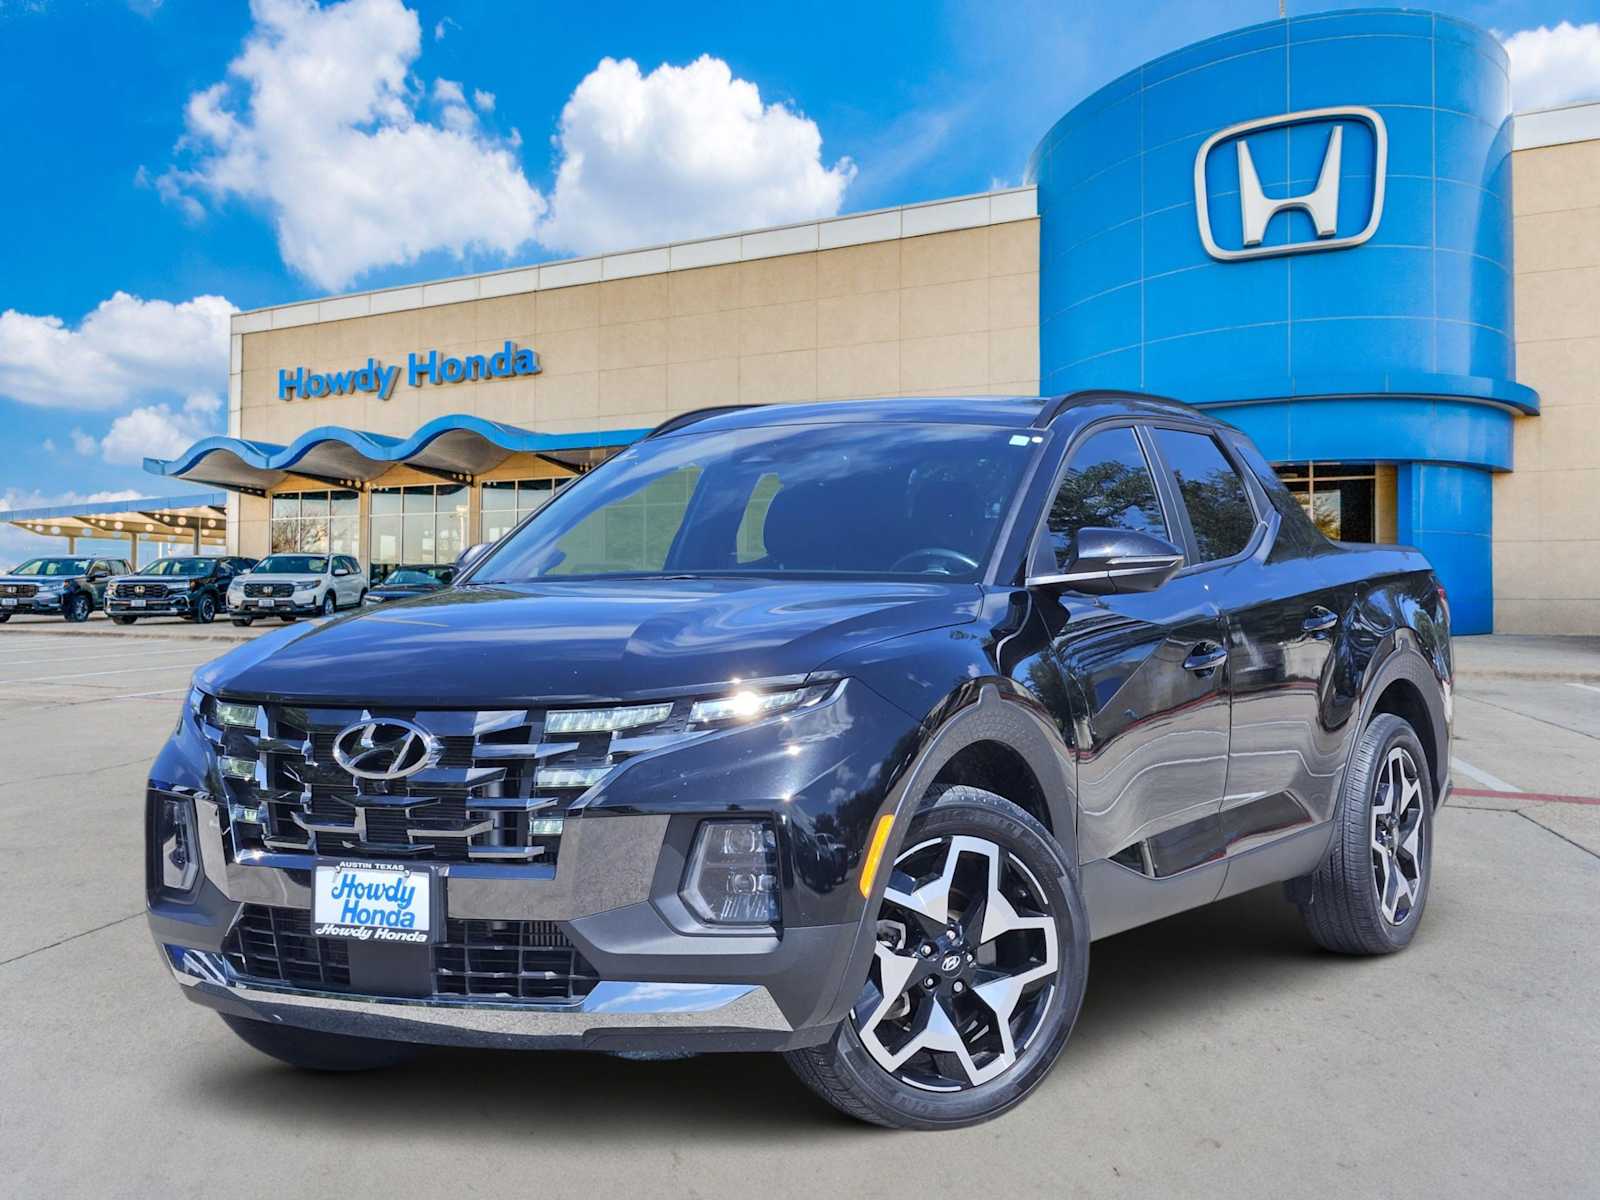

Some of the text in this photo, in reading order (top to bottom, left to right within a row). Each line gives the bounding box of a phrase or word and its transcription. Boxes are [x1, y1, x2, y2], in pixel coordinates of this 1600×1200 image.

[278, 341, 541, 400] Howdy Honda
[339, 861, 405, 871] AUSTIN TEXAS
[331, 873, 416, 909] Howdy
[340, 899, 416, 929] Honda
[315, 923, 428, 943] Howdy Honda
